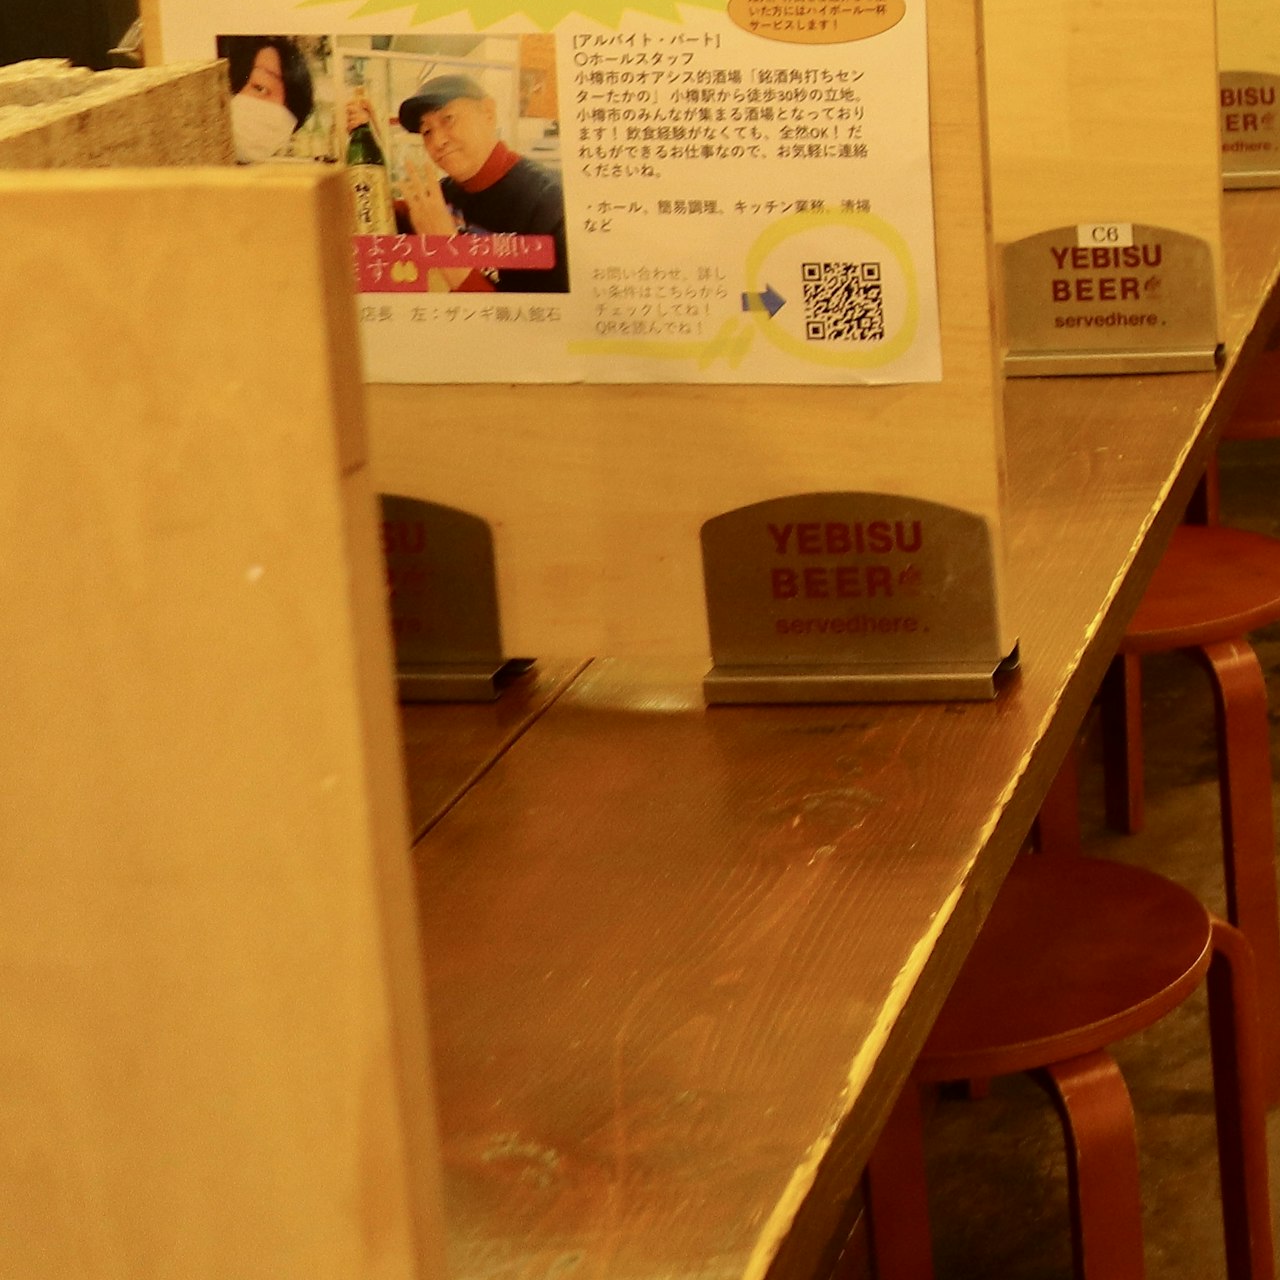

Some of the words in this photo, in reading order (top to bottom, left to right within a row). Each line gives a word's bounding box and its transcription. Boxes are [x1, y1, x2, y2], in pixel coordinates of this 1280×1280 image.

[584, 217, 613, 233] など
[1092, 224, 1119, 242] C6
[1051, 245, 1162, 270] YEBISU
[1052, 279, 1141, 302] BEER
[766, 521, 922, 555] YEBISU
[771, 568, 894, 599] BEER
